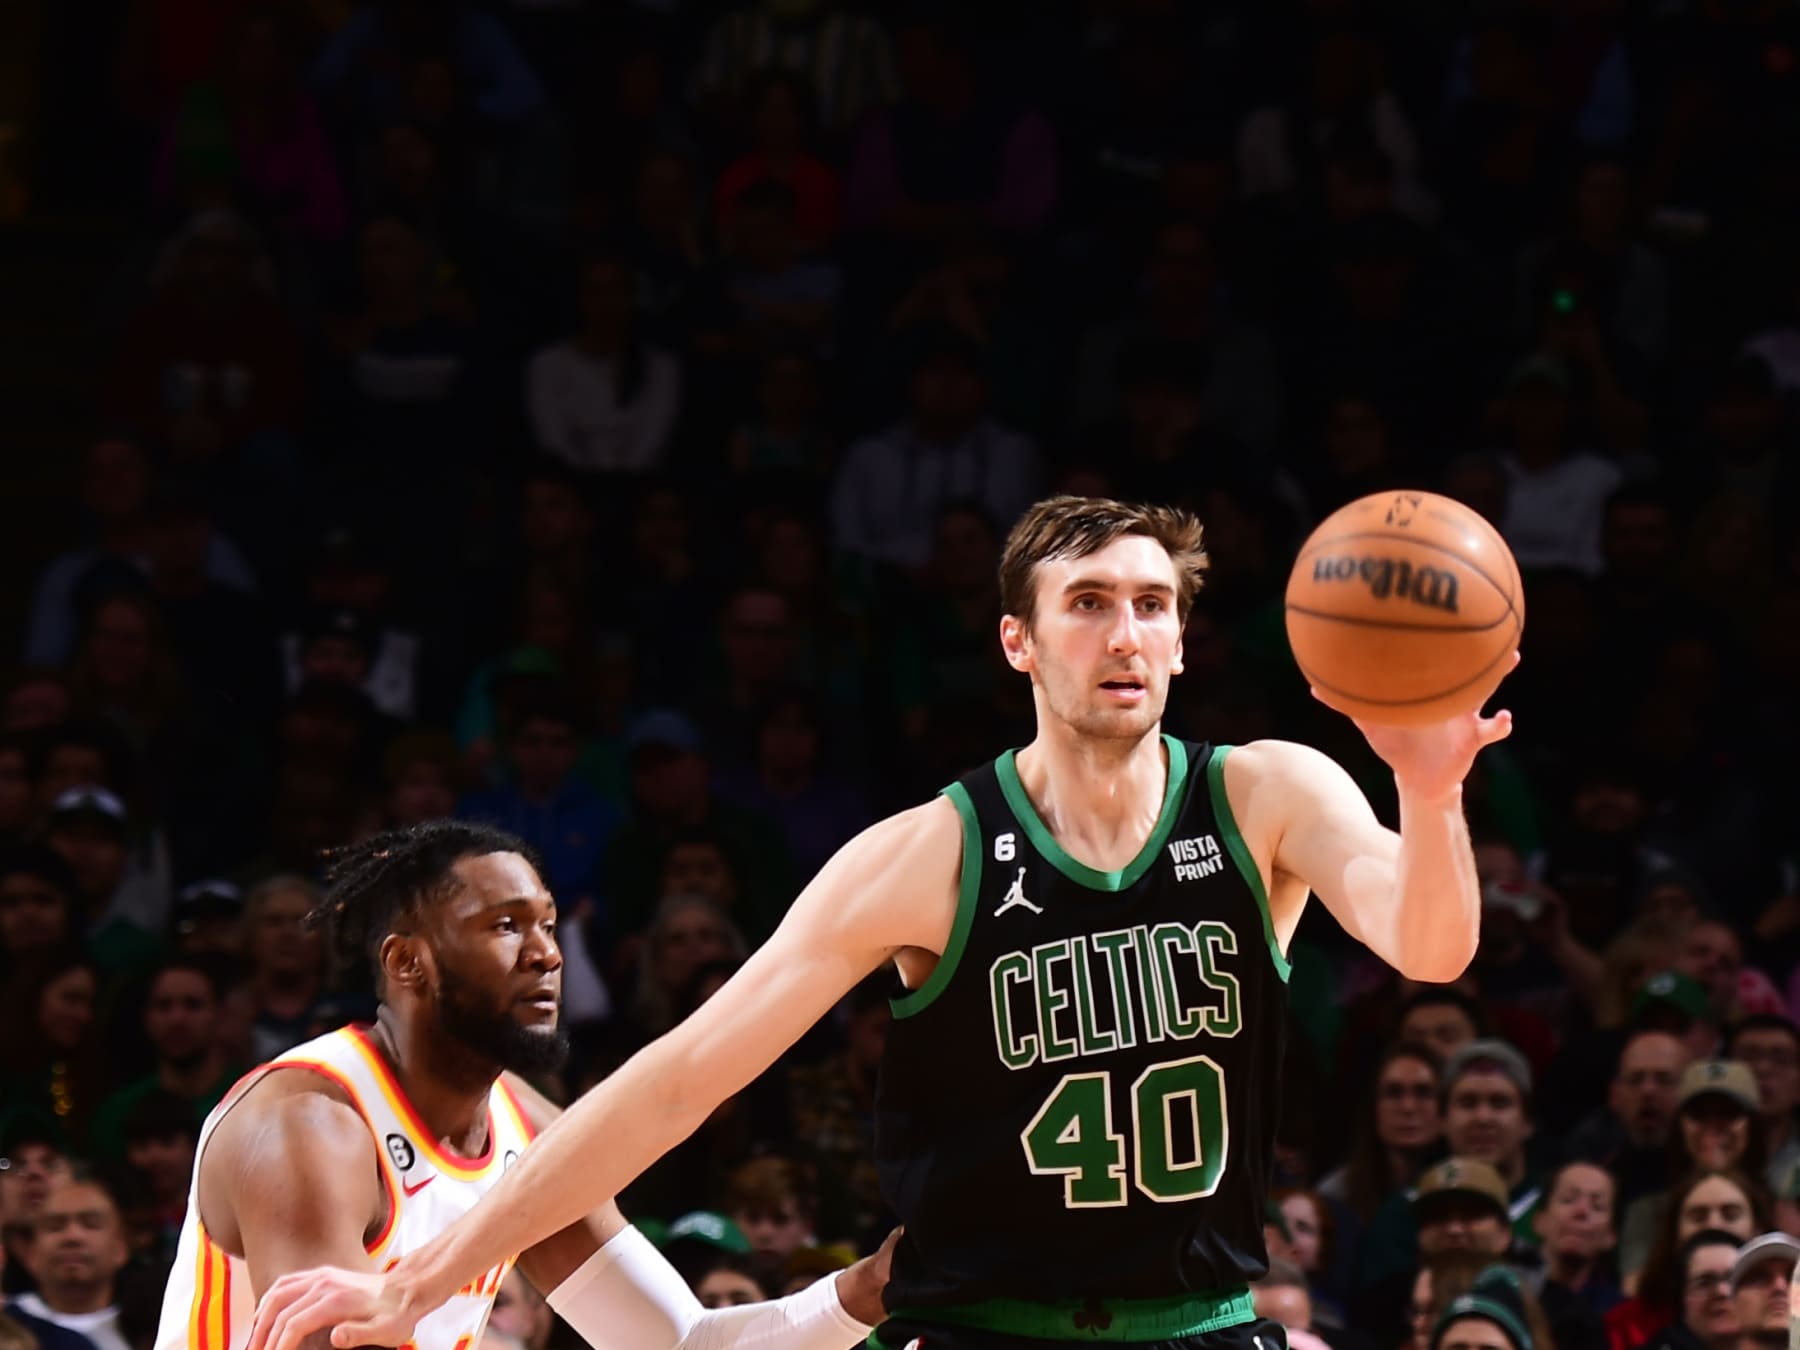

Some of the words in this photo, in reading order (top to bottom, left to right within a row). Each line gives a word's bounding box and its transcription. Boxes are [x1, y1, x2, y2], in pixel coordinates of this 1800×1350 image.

[994, 832, 1016, 861] 6
[1168, 834, 1220, 864] VISTA
[1174, 854, 1224, 882] PRINT
[990, 921, 1243, 1070] CELTICS
[1020, 1055, 1229, 1208] 40
[388, 1136, 412, 1169] 6
